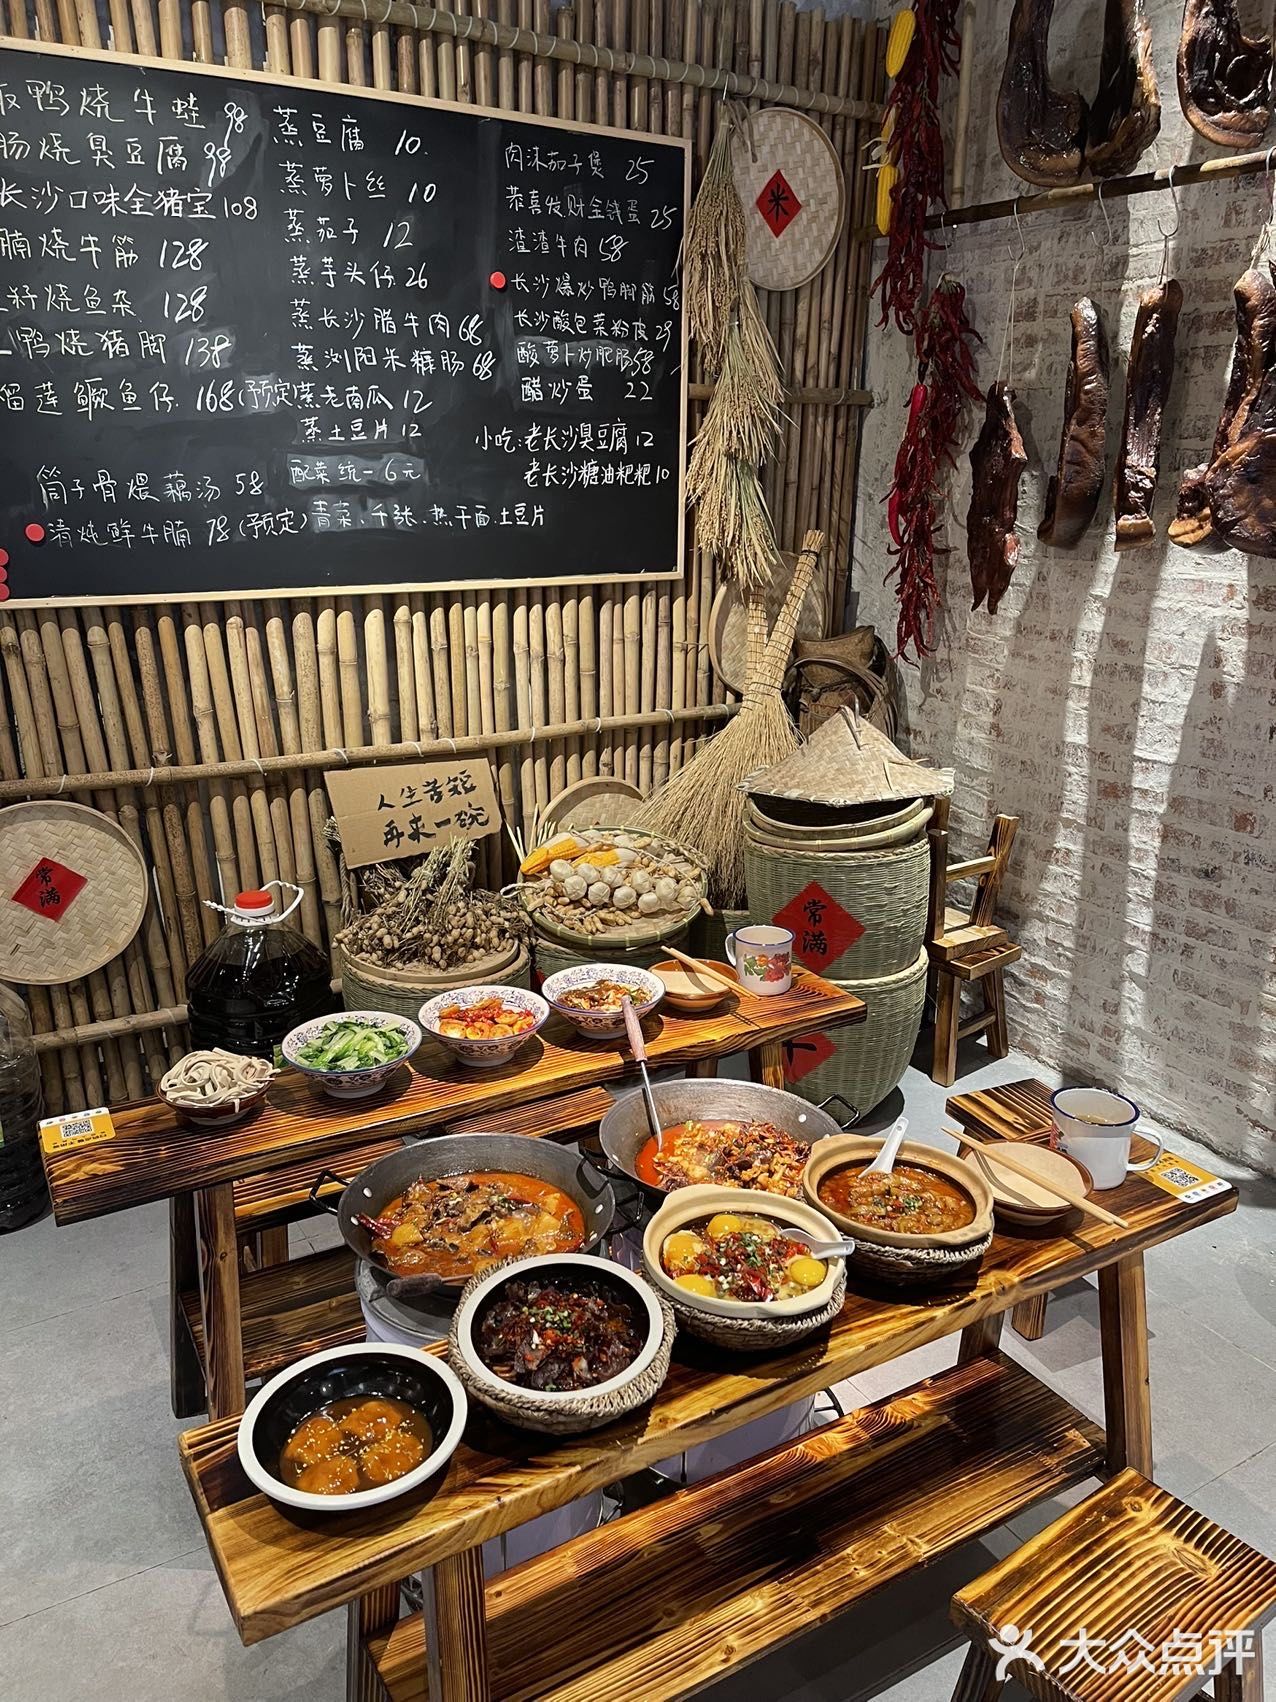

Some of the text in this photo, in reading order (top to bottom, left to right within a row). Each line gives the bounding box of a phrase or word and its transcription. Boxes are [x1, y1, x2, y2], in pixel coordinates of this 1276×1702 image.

[222, 102, 248, 148] 98
[204, 140, 231, 187] 98
[625, 157, 654, 184] 25
[409, 183, 436, 203] 10
[768, 182, 789, 221] 米
[224, 196, 257, 220] 108
[651, 205, 677, 230] 25
[383, 222, 413, 249] 12
[599, 234, 629, 262] 58
[160, 238, 209, 270] 128
[406, 262, 427, 289] 26
[0, 284, 207, 323] 籽烧鱼杂 128
[663, 284, 679, 310] 58
[459, 314, 483, 345] 68
[656, 321, 672, 352] 29
[0, 327, 234, 368] 鸭烧猪脚 138
[630, 347, 654, 376] 58
[473, 351, 496, 380] 68
[197, 379, 235, 412] 168
[404, 390, 432, 413] 12
[624, 381, 653, 401] 22
[402, 424, 422, 437] 12
[637, 432, 654, 447] 12
[236, 471, 264, 495] 58
[656, 466, 669, 483] 10
[206, 516, 230, 546] 78
[378, 769, 477, 811] 人生苦短
[383, 801, 490, 848] 再来一碗
[802, 899, 828, 955] 常满
